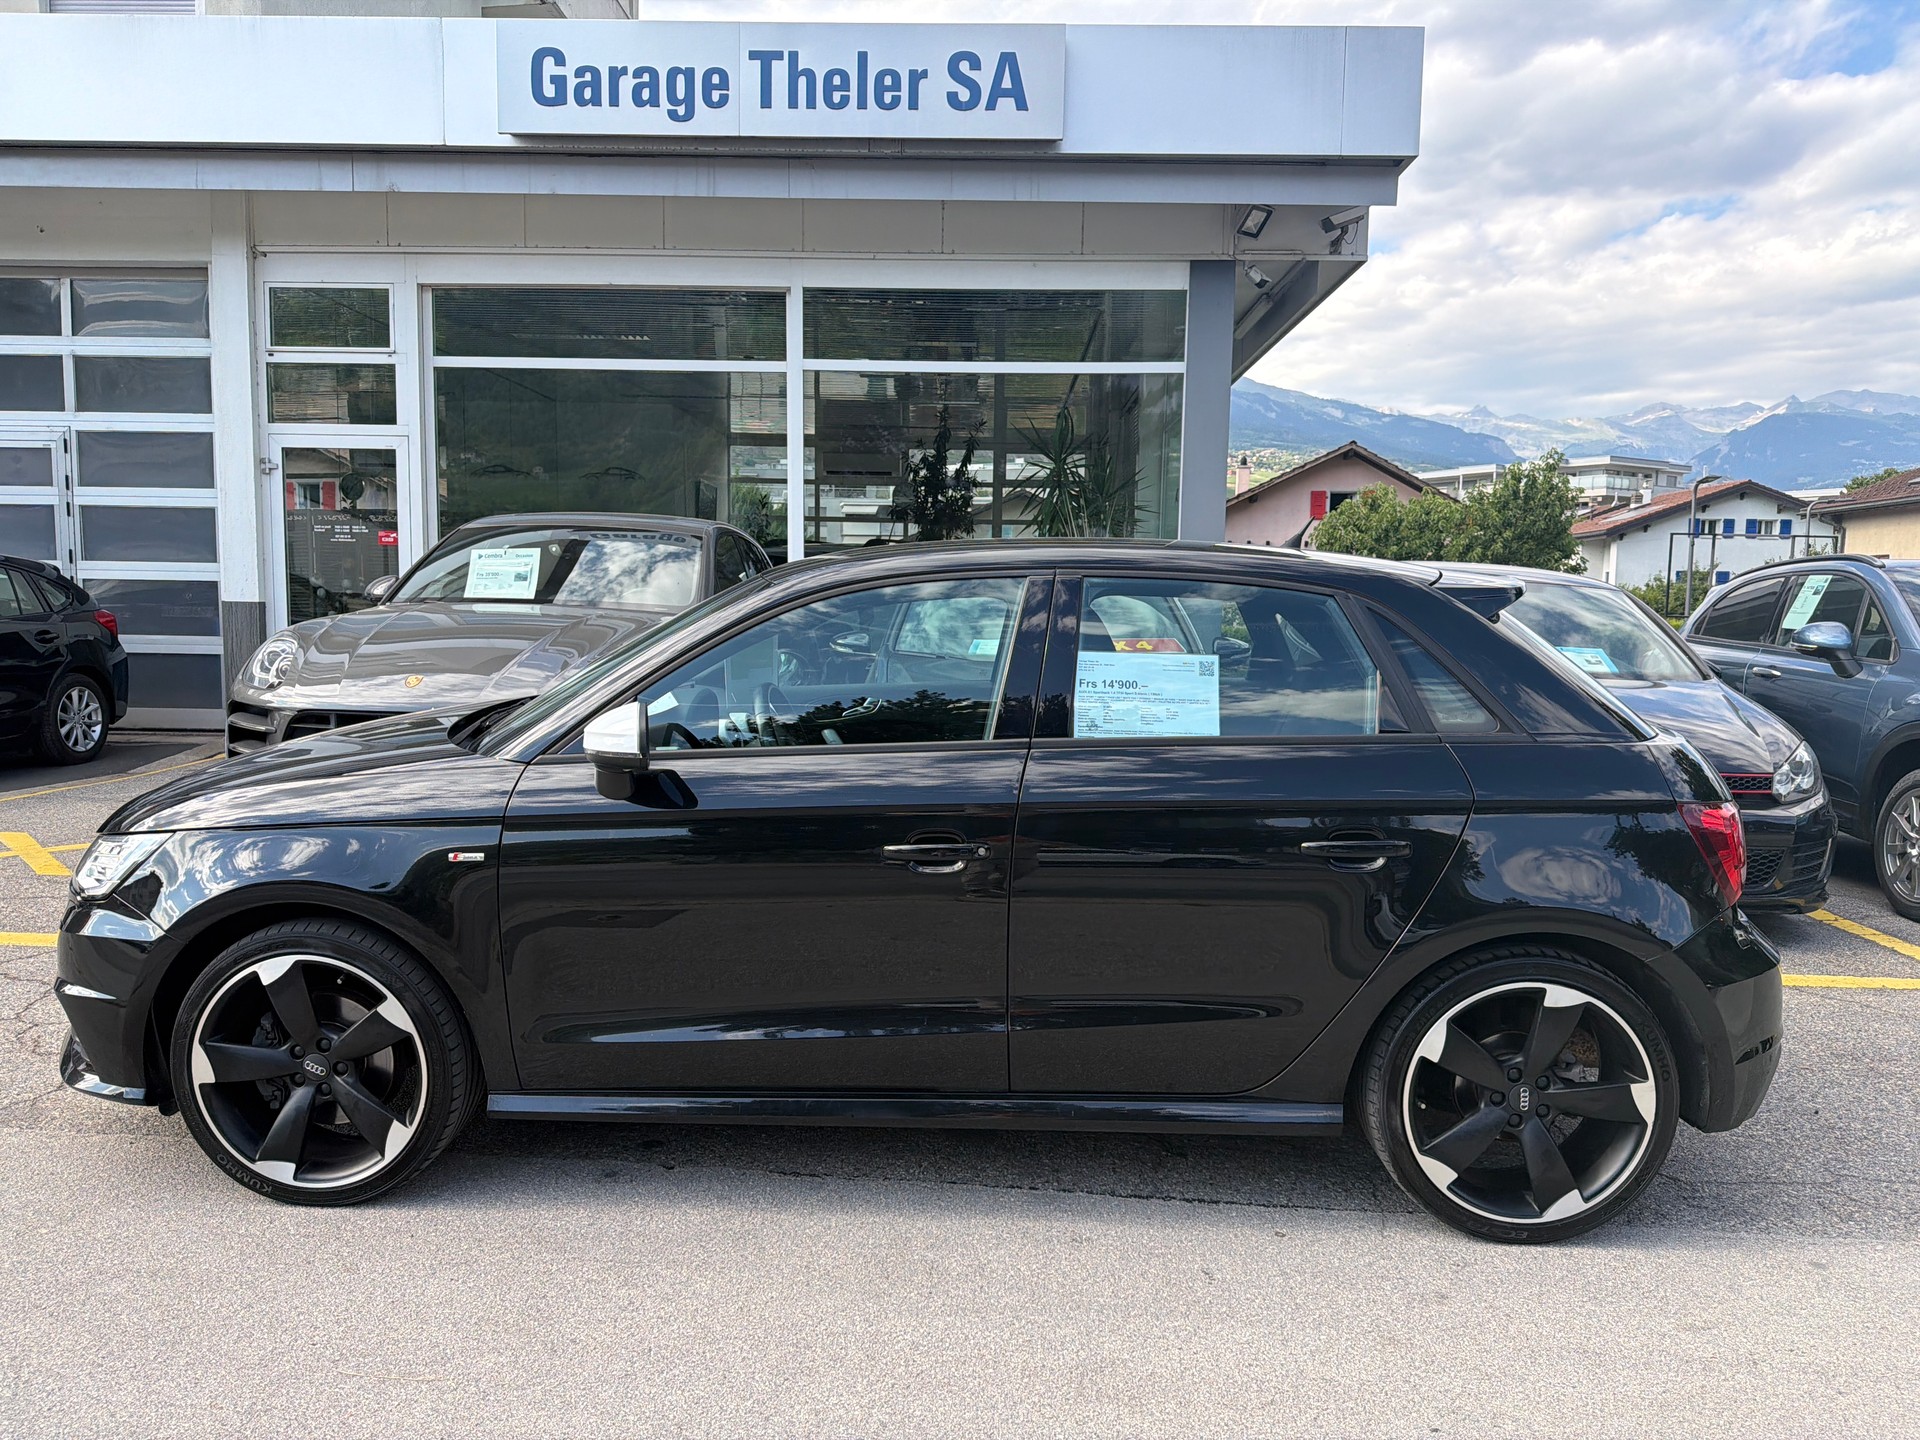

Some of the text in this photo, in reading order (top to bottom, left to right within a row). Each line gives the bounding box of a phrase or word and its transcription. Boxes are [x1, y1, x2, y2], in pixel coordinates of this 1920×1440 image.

[530, 46, 1030, 122] Garage Theler SA
[1079, 678, 1098, 689] Frs
[217, 1153, 273, 1194] KUMHO
